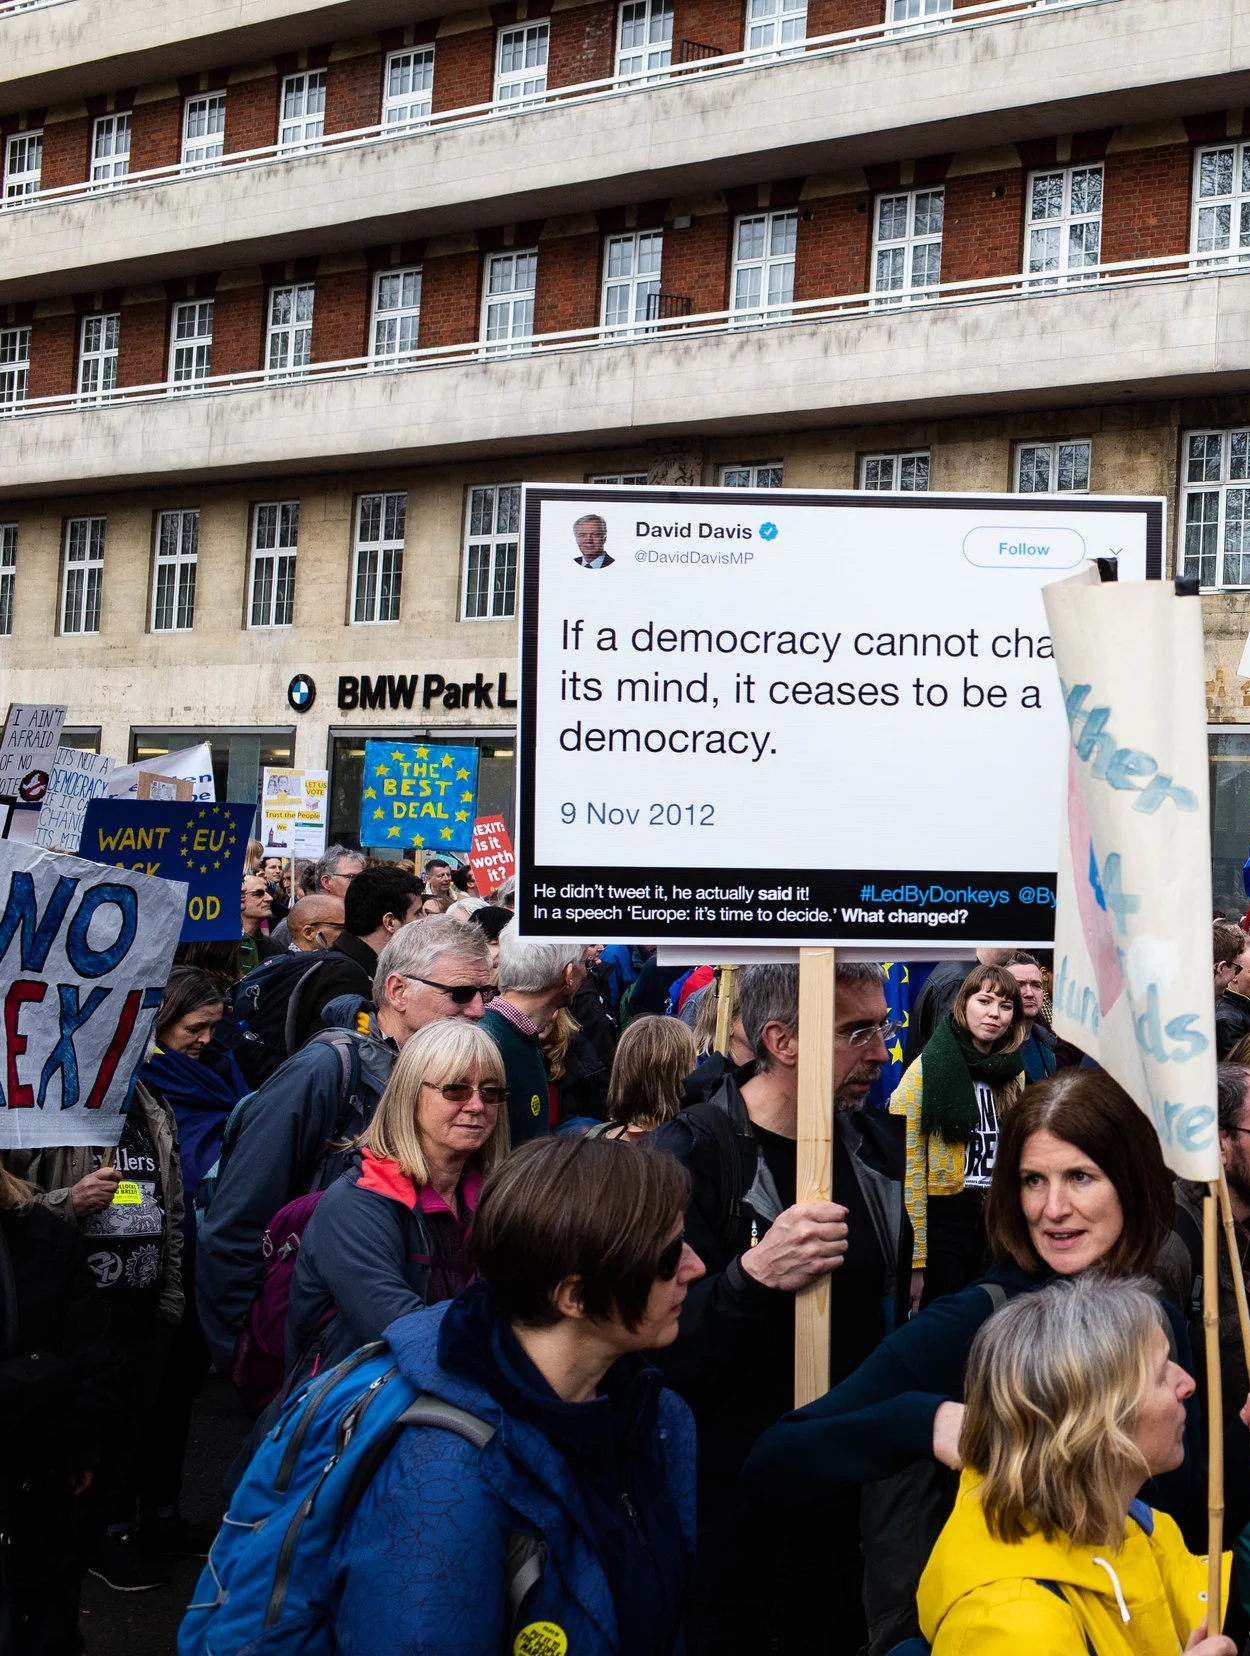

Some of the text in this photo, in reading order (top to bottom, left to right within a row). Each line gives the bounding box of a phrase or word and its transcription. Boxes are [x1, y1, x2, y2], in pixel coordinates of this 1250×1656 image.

[635, 521, 753, 539] David Davis
[634, 550, 754, 565] @DavidDavisMP
[998, 542, 1050, 556] Follow
[562, 619, 585, 650] If
[596, 626, 618, 651] a
[631, 620, 841, 663] democracy
[854, 628, 979, 658] cannot
[337, 674, 419, 710] BMW
[423, 672, 494, 709] Park
[561, 669, 1042, 708] its mind, it ceases to be a
[12, 707, 65, 729] I AIN'T
[8, 729, 54, 749] AFRAID
[559, 720, 777, 762] democracy.
[0, 754, 33, 771] OF NO
[55, 748, 109, 775] ITS NOT A
[400, 761, 440, 778] THE
[0, 777, 21, 795] OTE
[47, 767, 110, 799] DEMOCRACY
[306, 788, 325, 796] VOTE
[383, 778, 453, 797] BEST
[43, 791, 57, 806] IF
[59, 793, 74, 808] IT
[297, 811, 321, 821] People
[392, 801, 450, 819] DEAL
[560, 801, 716, 826] 9 Nov 2012
[98, 827, 226, 852] WANT EU
[474, 836, 502, 852] is it
[471, 850, 514, 869] worth
[486, 867, 507, 882] it?
[534, 883, 809, 904] He didn’t tweet it, he actually said it!
[860, 885, 1057, 908] #LedByDonkeys @By
[0, 871, 139, 980] NO
[534, 904, 969, 927] In a speech ‘Europe: it’s time to decide.’ What changed?
[0, 979, 167, 1115] EXIT
